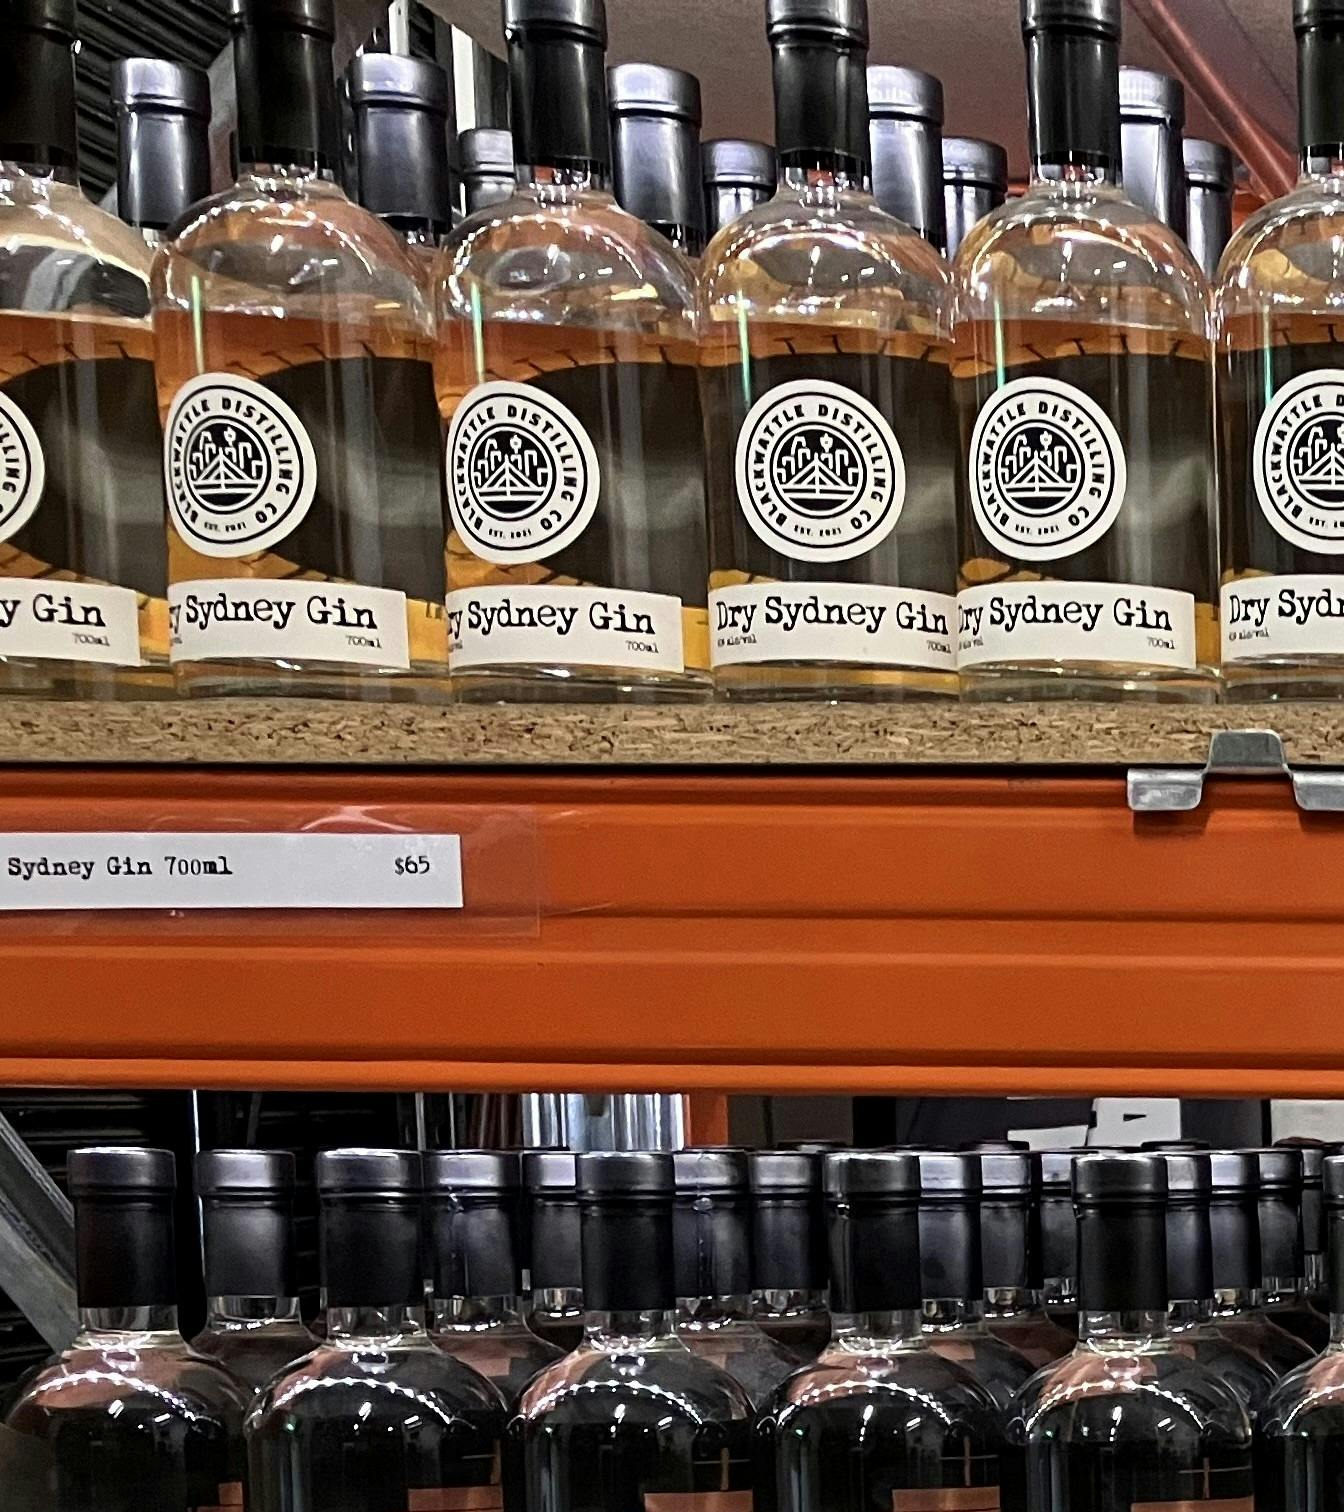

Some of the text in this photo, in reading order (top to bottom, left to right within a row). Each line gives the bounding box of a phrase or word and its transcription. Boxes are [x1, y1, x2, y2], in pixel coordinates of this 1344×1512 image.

[33, 594, 106, 627] Gin
[186, 593, 296, 630] Sydney
[307, 596, 377, 629] Gin
[468, 599, 578, 636] Sydney
[589, 602, 655, 634] Gin
[716, 596, 948, 635] Dry Sydney Gin
[990, 595, 1172, 632] Sydney Gin
[1230, 595, 1270, 627] Dry
[8, 856, 233, 880] Sydney Gin 700ml
[394, 855, 430, 876] $65
